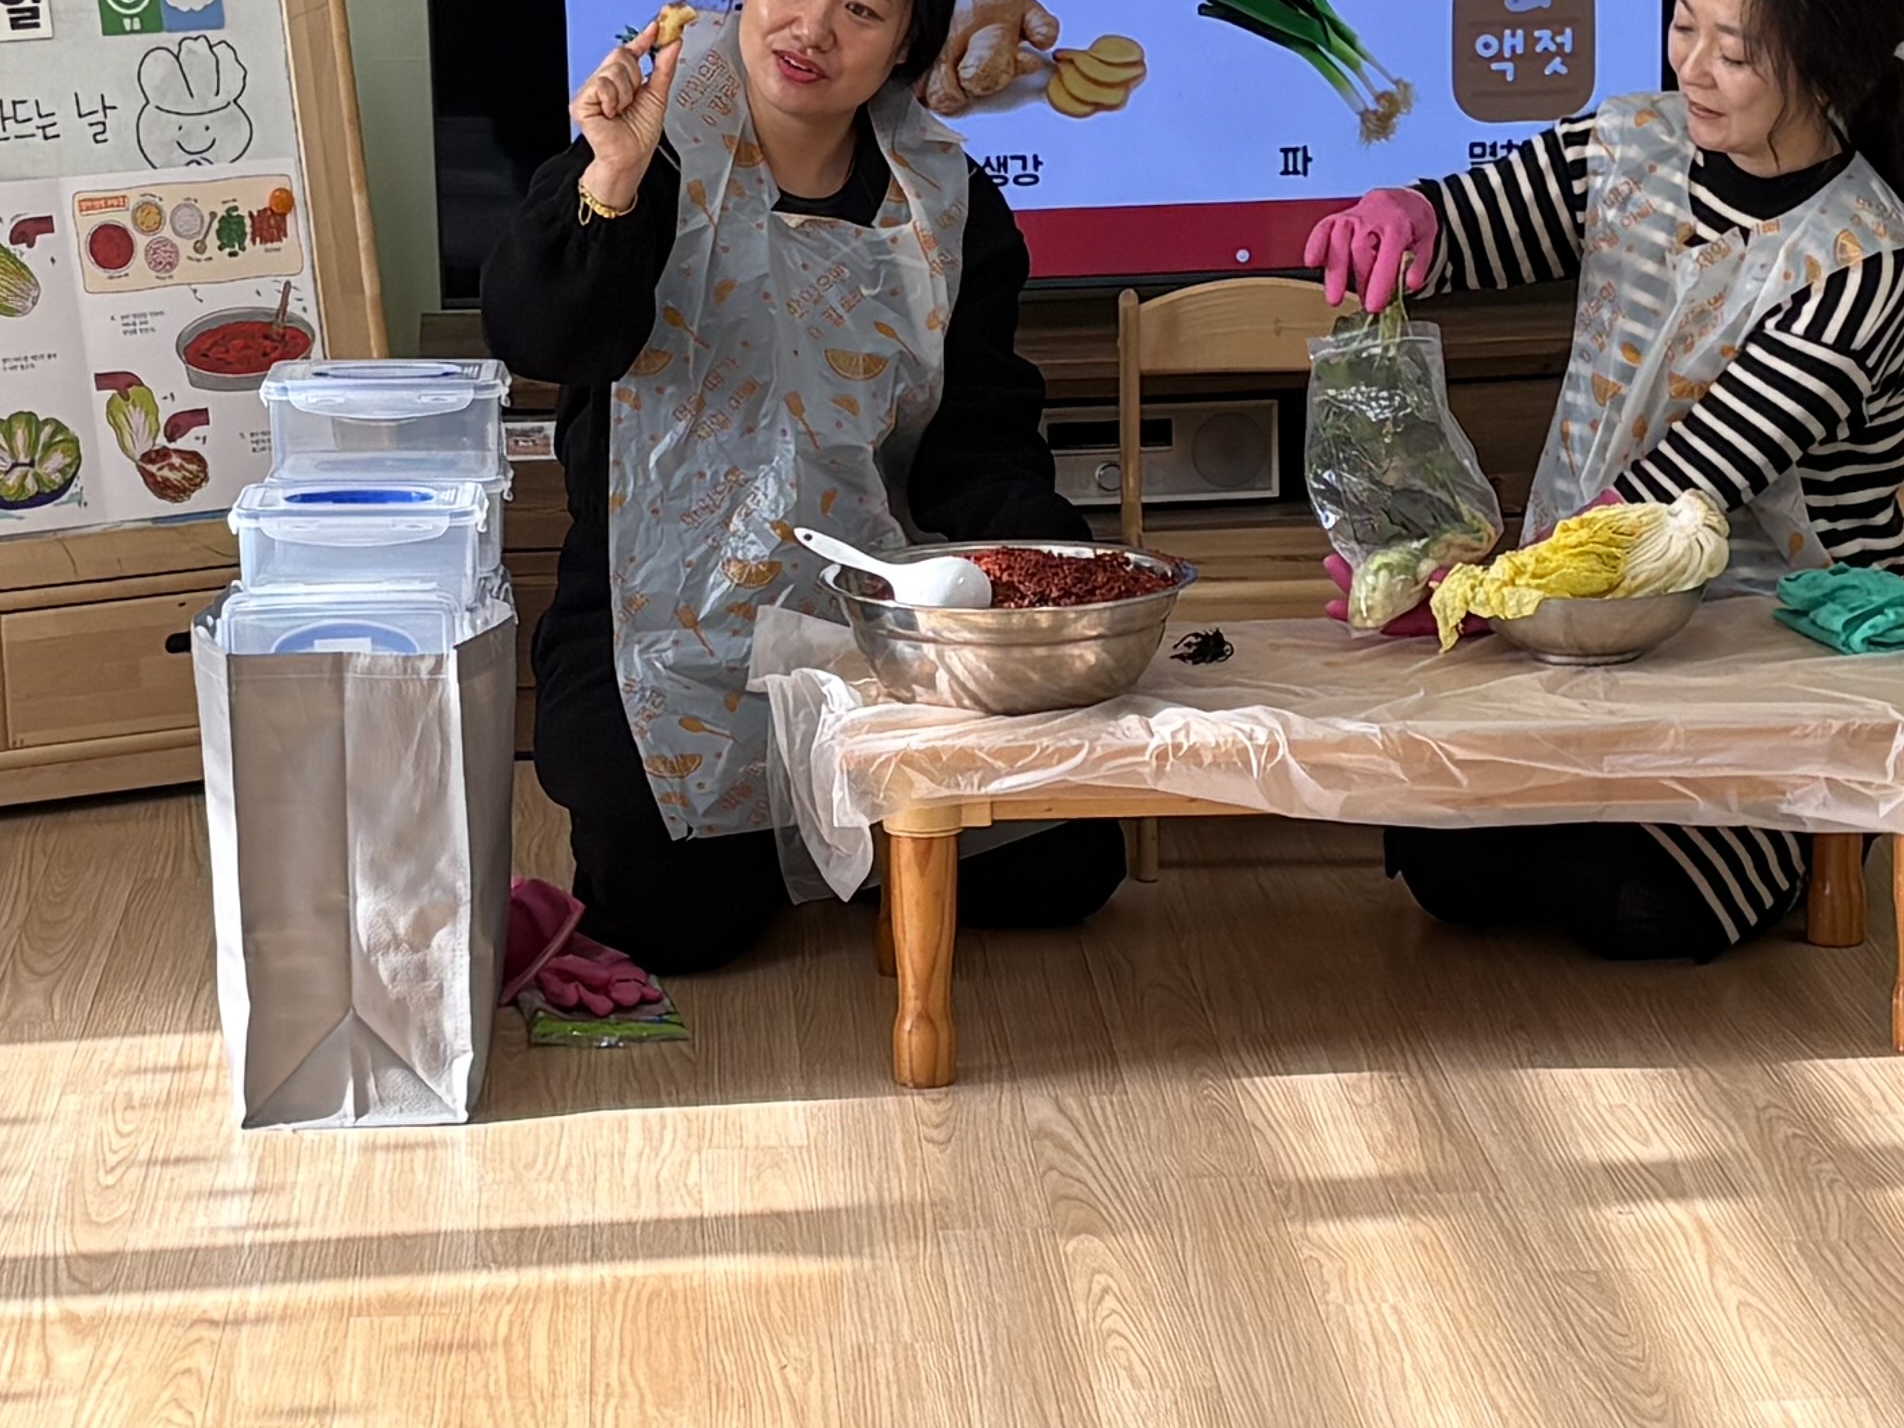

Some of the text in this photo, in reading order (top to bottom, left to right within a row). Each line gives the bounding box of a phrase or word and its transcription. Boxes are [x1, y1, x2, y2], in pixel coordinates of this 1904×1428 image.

[1474, 34, 1576, 85] 액젓
[73, 92, 119, 146] 날
[981, 154, 1044, 187] 생강
[1278, 145, 1312, 179] 파
